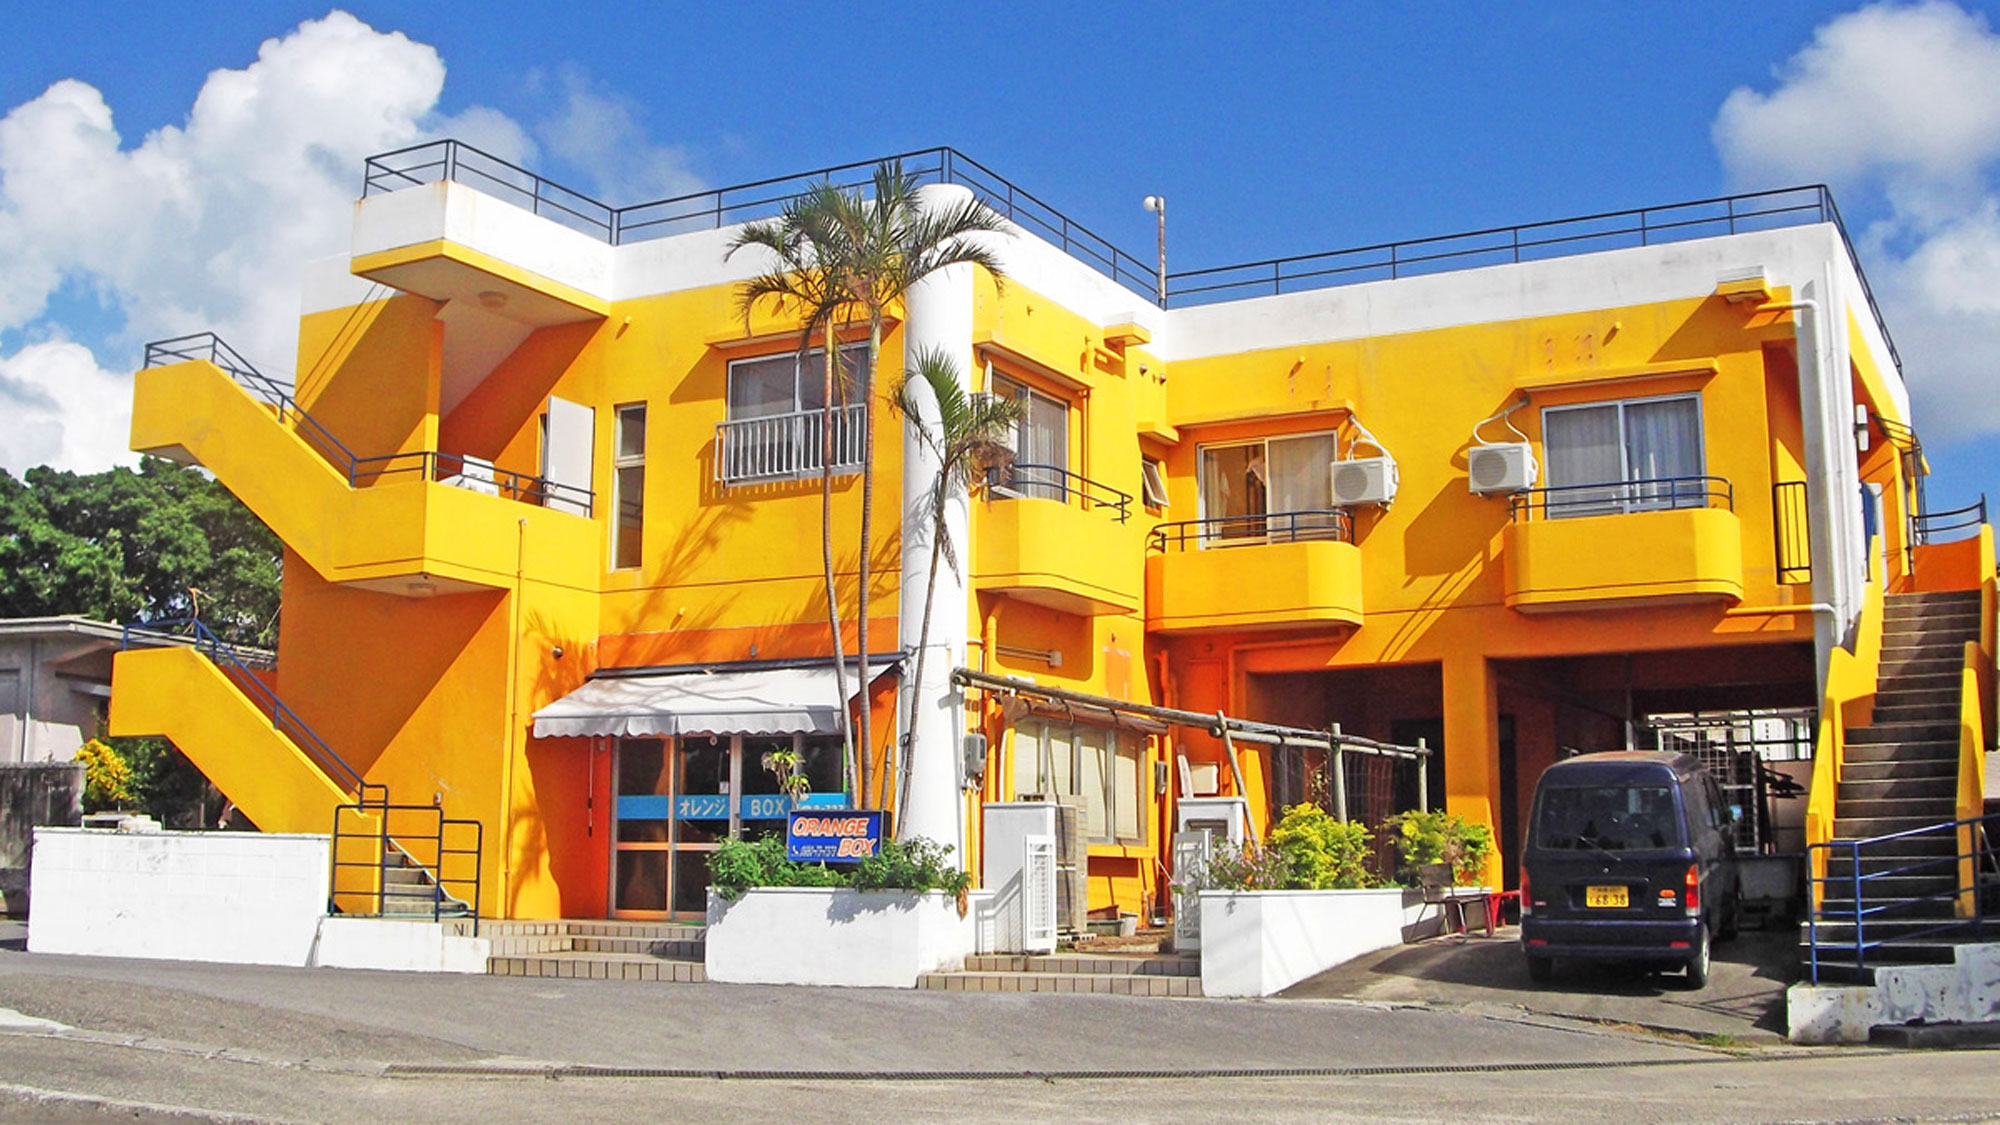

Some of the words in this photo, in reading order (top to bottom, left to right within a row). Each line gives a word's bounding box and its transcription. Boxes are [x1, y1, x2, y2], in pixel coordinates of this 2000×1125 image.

[680, 798, 726, 816] オレンジ
[751, 798, 785, 816] BOX
[792, 817, 870, 836] ORANGE
[837, 838, 877, 857] BOX
